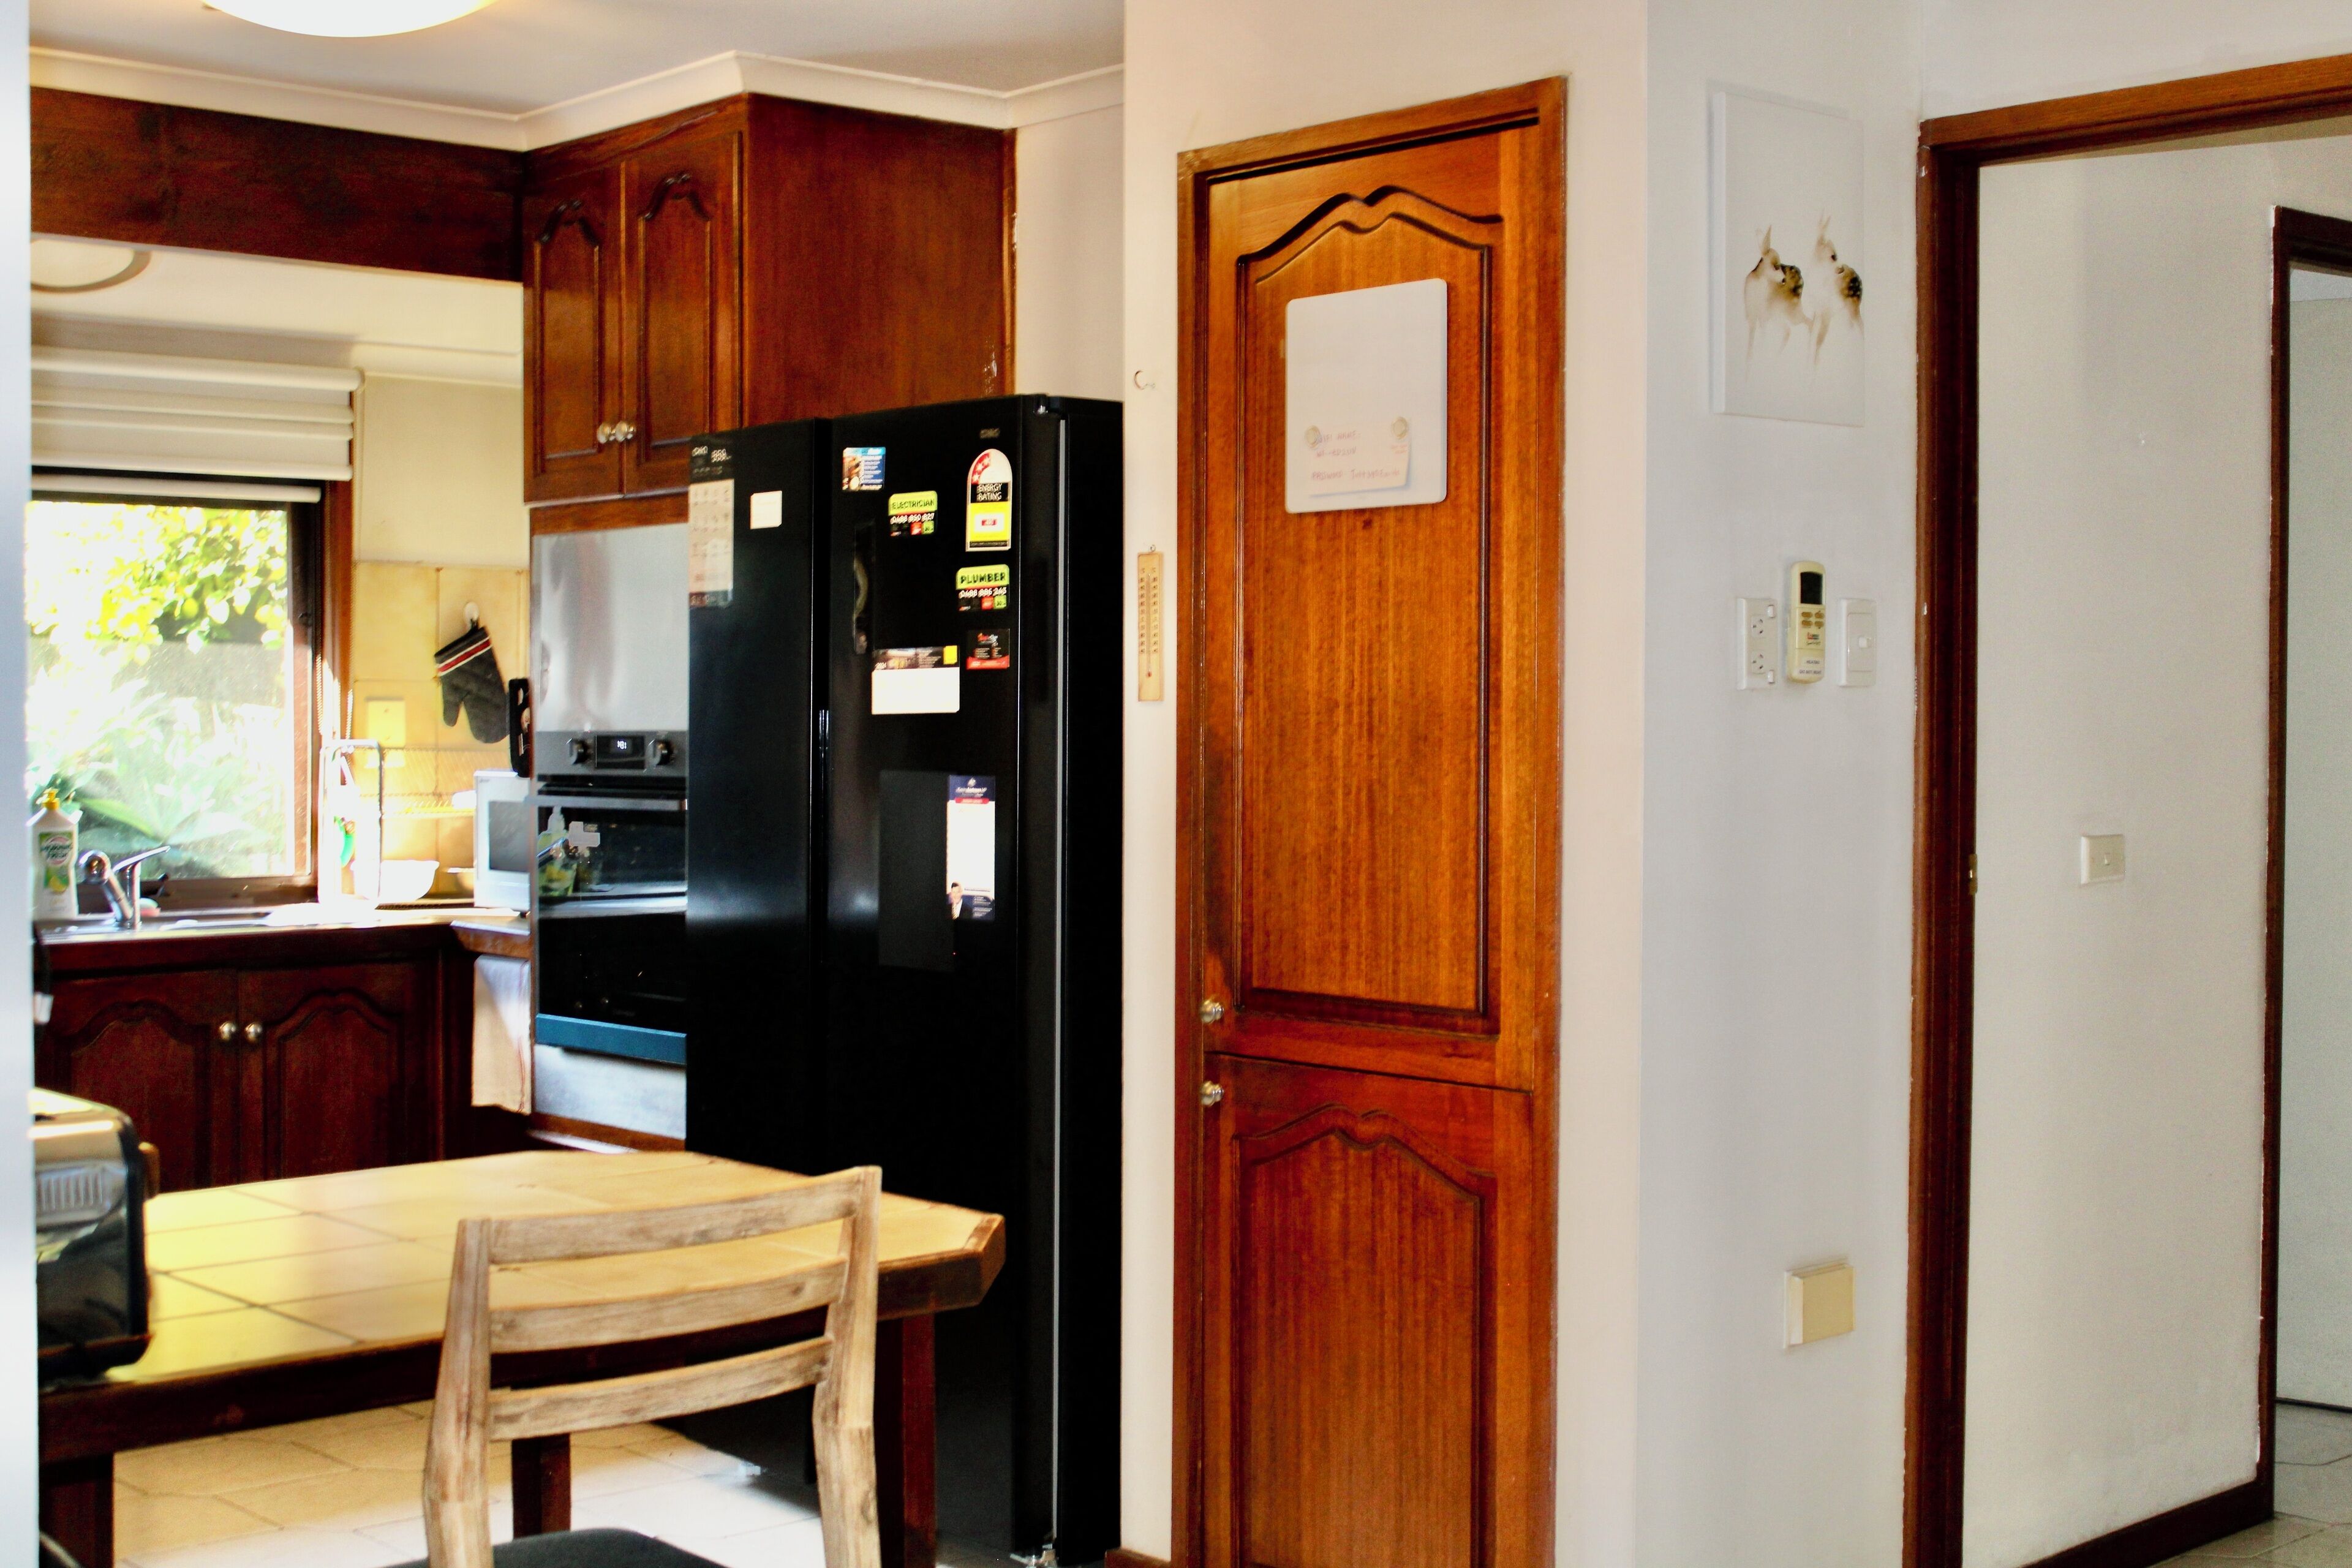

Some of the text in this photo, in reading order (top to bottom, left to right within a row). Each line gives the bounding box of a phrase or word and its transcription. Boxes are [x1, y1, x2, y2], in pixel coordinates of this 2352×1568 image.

[978, 483, 1003, 493] ENERGY
[978, 492, 1002, 502] RATING
[892, 499, 935, 510] ELECTRICIAN
[960, 572, 1006, 584] PLUMBER
